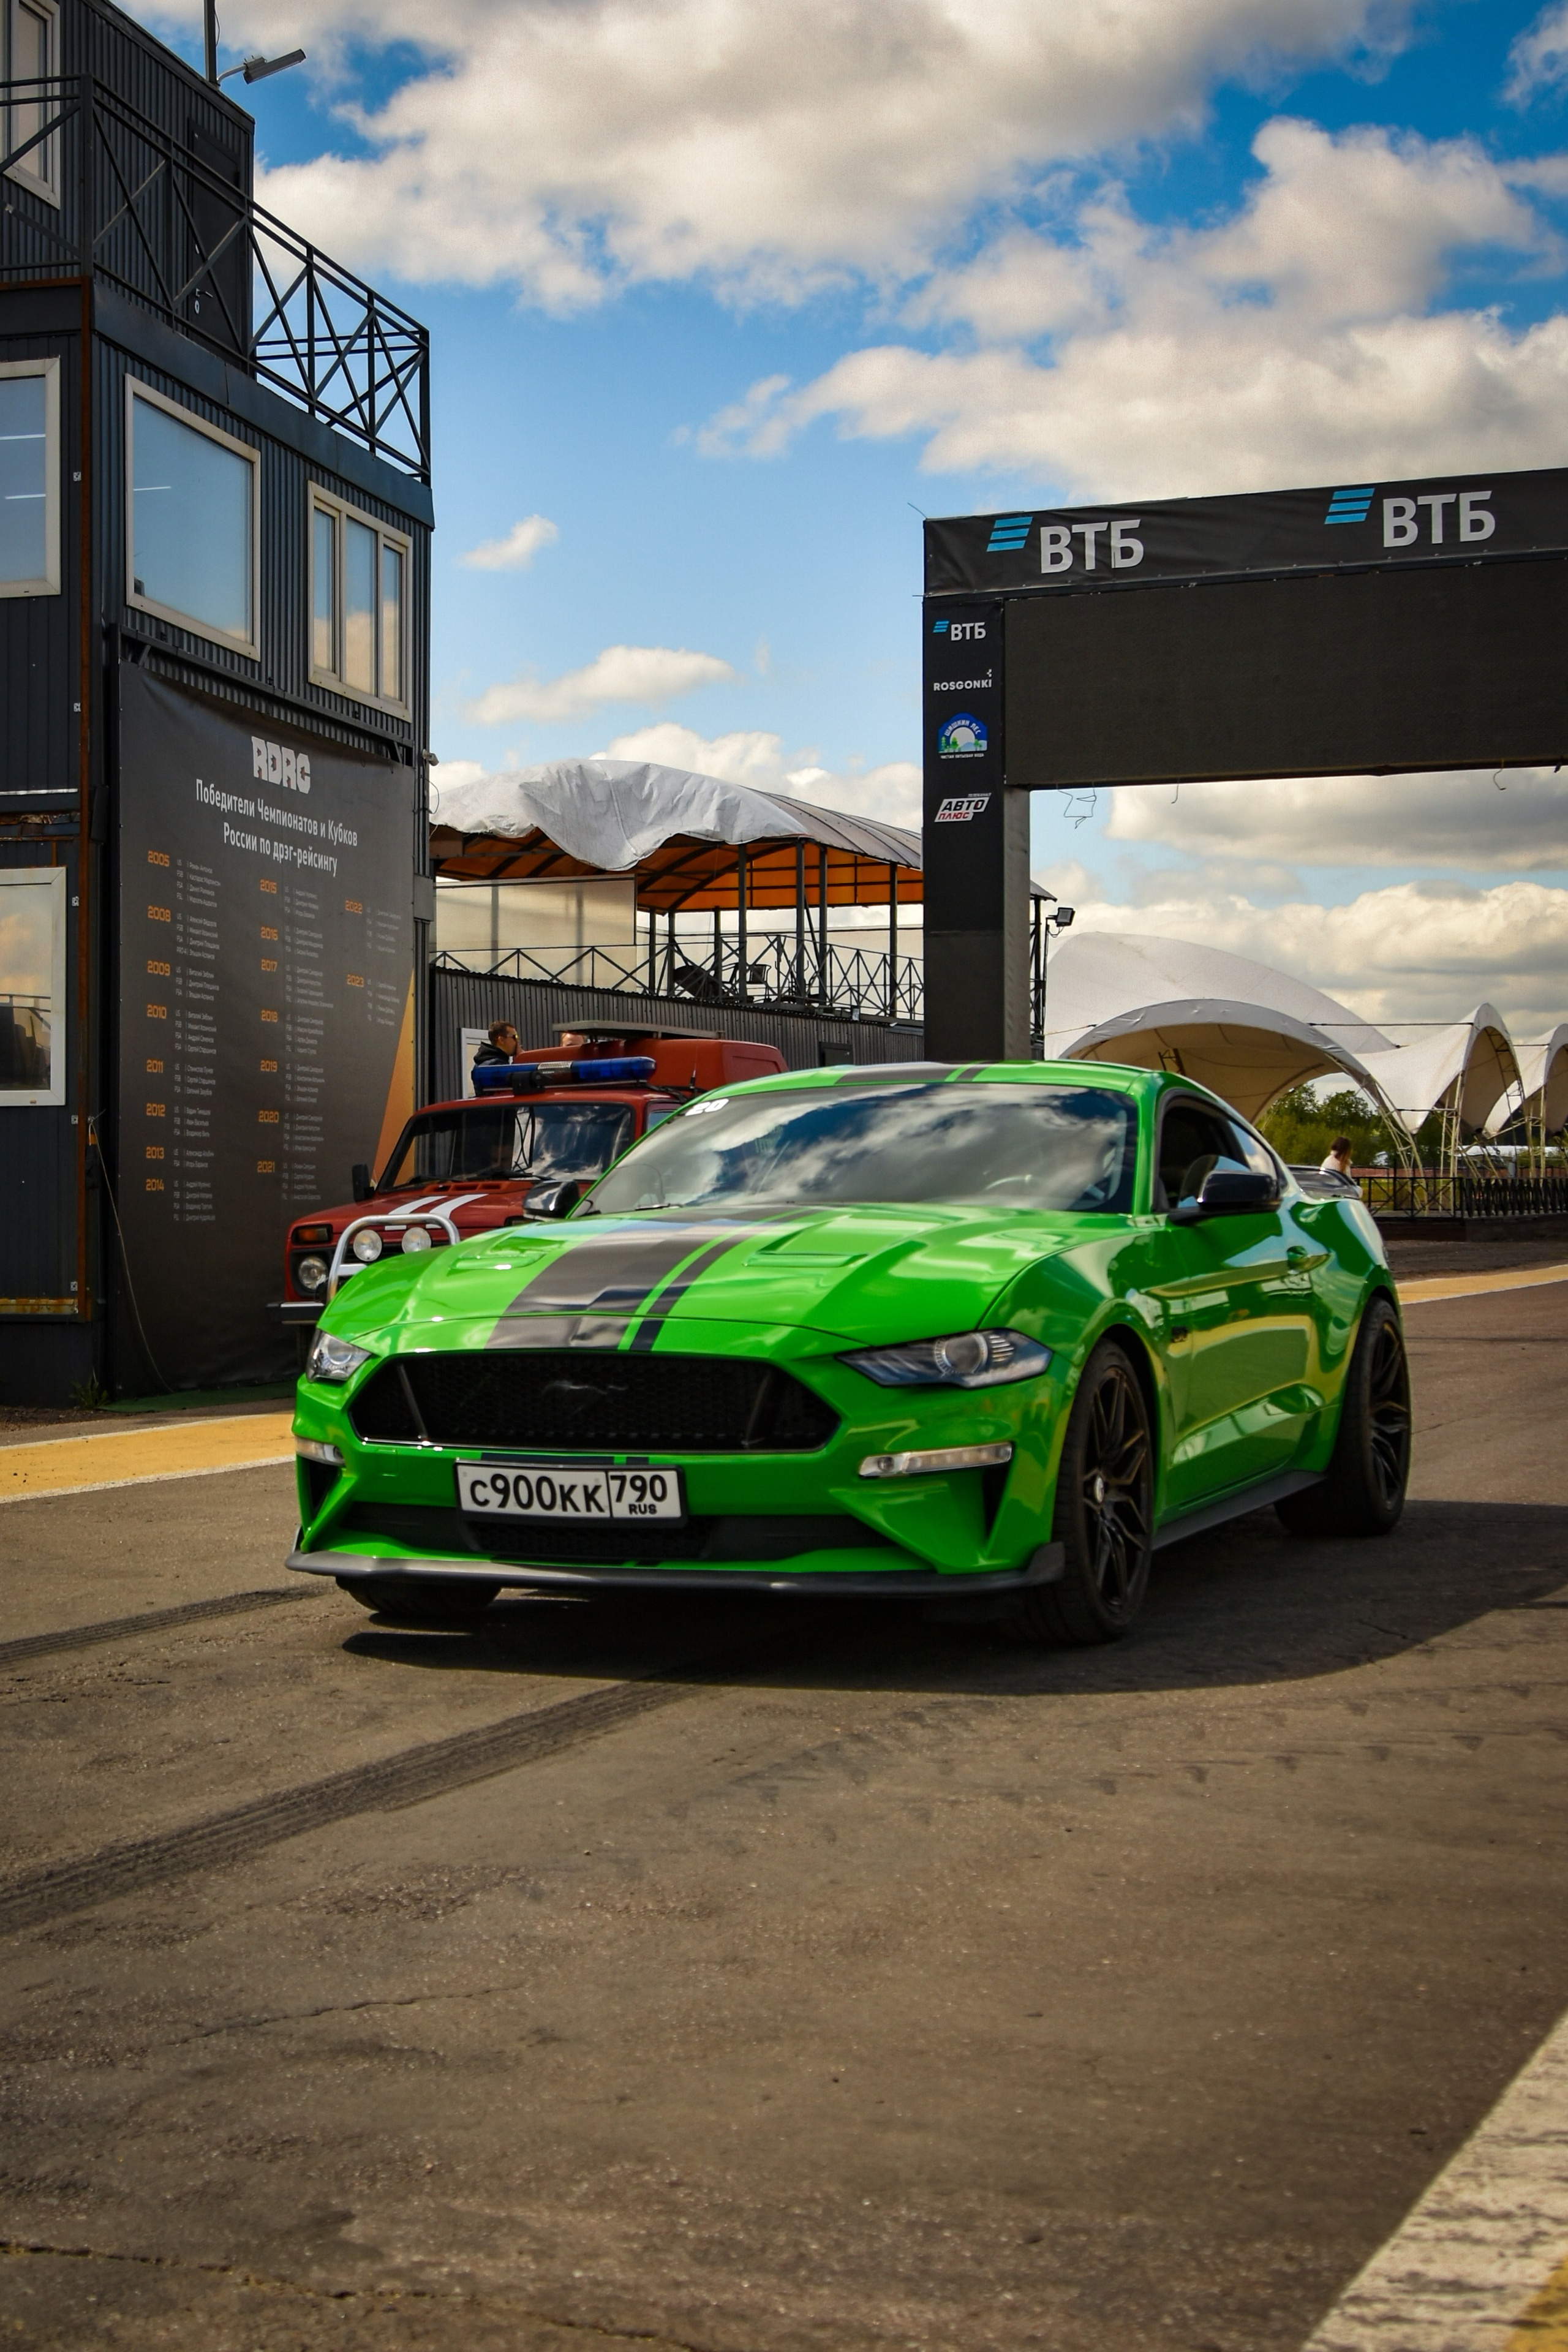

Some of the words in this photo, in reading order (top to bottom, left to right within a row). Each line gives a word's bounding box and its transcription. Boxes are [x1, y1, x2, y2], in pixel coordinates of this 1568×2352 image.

[1382, 491, 1496, 548] ВТБ
[1040, 519, 1144, 573] ВТБ
[951, 622, 986, 641] ВТБ
[933, 679, 992, 691] ROSGONKI
[251, 736, 311, 794] RDRC
[196, 778, 255, 818] Победители
[257, 798, 318, 835] Чемпионатов
[320, 822, 326, 838] и
[328, 820, 358, 846] Кубков
[941, 799, 985, 812] АВТО
[224, 822, 257, 851] России
[260, 838, 271, 855] по
[273, 842, 337, 877] дрэг-рейсингу
[148, 850, 170, 867] 2005
[260, 879, 277, 894] 2015
[148, 906, 171, 922] 2008
[261, 926, 278, 941] 2016
[148, 960, 170, 976] 2009
[261, 959, 277, 972] 2017
[147, 1005, 167, 1019] 2010
[146, 1059, 164, 1073] 2011
[260, 1060, 278, 1072] 2019
[146, 1103, 165, 1117] 2012
[685, 1098, 729, 1117] 20
[258, 1110, 279, 1123] 2020
[146, 1146, 165, 1159] 2013
[146, 1178, 165, 1191] 2014
[609, 1474, 668, 1503] 790
[628, 1504, 657, 1515] RUS
